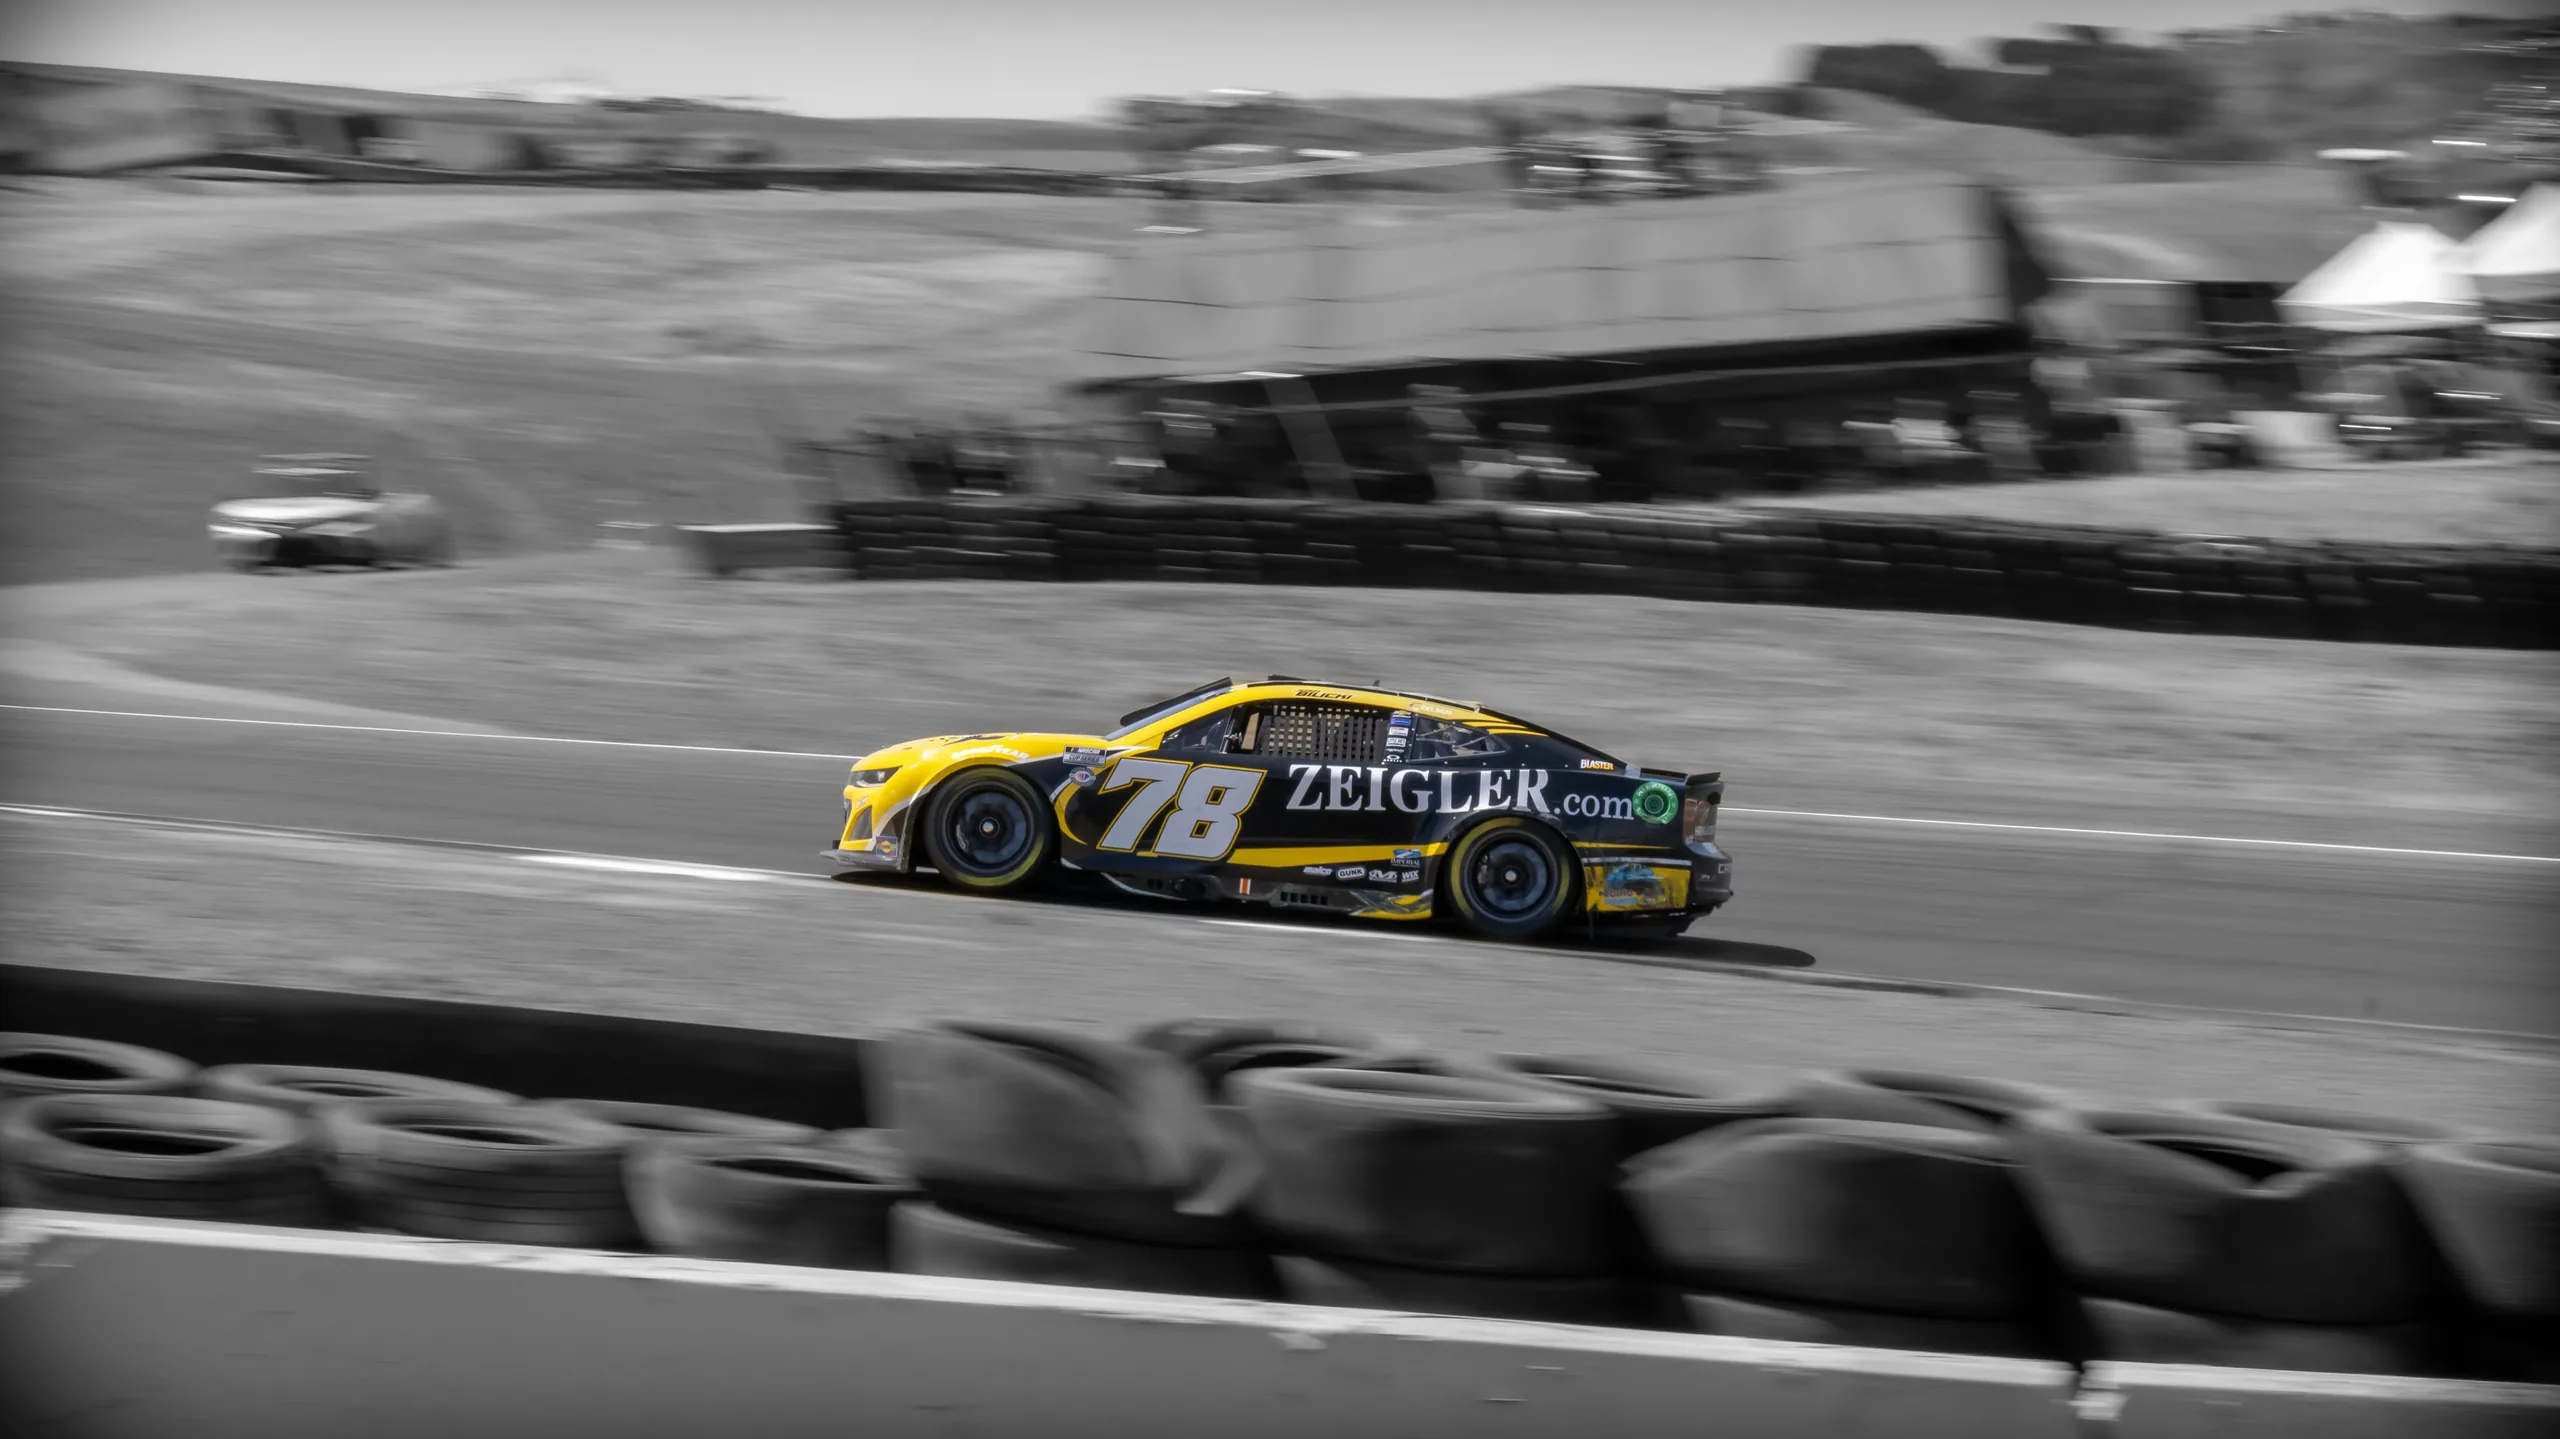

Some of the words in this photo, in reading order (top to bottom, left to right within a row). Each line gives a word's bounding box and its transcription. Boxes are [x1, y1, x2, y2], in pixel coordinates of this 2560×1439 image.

[1096, 757, 1268, 862] 78
[1286, 764, 1635, 821] ZEIGLER.com
[1339, 869, 1363, 877] GUNK
[1402, 870, 1419, 881] WIX
